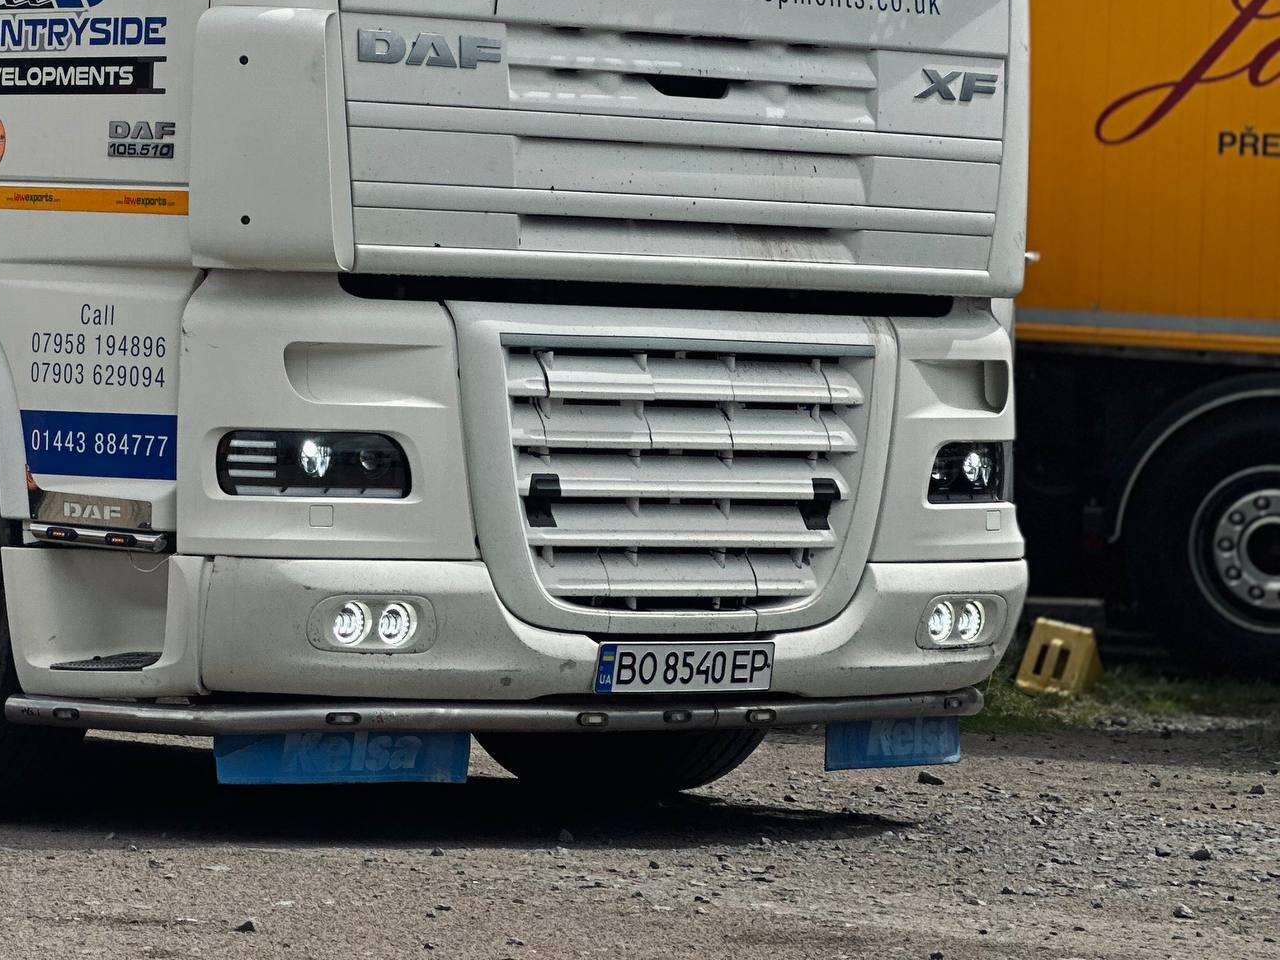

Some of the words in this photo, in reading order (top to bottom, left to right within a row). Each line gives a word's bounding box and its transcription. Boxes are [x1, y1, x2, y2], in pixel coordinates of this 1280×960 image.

[356, 27, 502, 69] DAF
[914, 66, 998, 103] XF
[108, 121, 176, 139] DAF
[109, 143, 174, 157] 105.510
[81, 303, 115, 326] Call
[31, 332, 86, 355] 07958
[95, 334, 166, 358] 194896
[30, 362, 84, 385] 07903
[93, 365, 166, 388] 629094
[31, 429, 86, 454] 01443
[94, 432, 169, 457] 884777
[63, 501, 121, 520] DAF
[616, 651, 657, 685] BO
[663, 650, 727, 684] 8540
[730, 649, 769, 684] EP
[599, 676, 611, 685] UA
[867, 720, 949, 756] Kels
[282, 732, 421, 772] Kelsa
